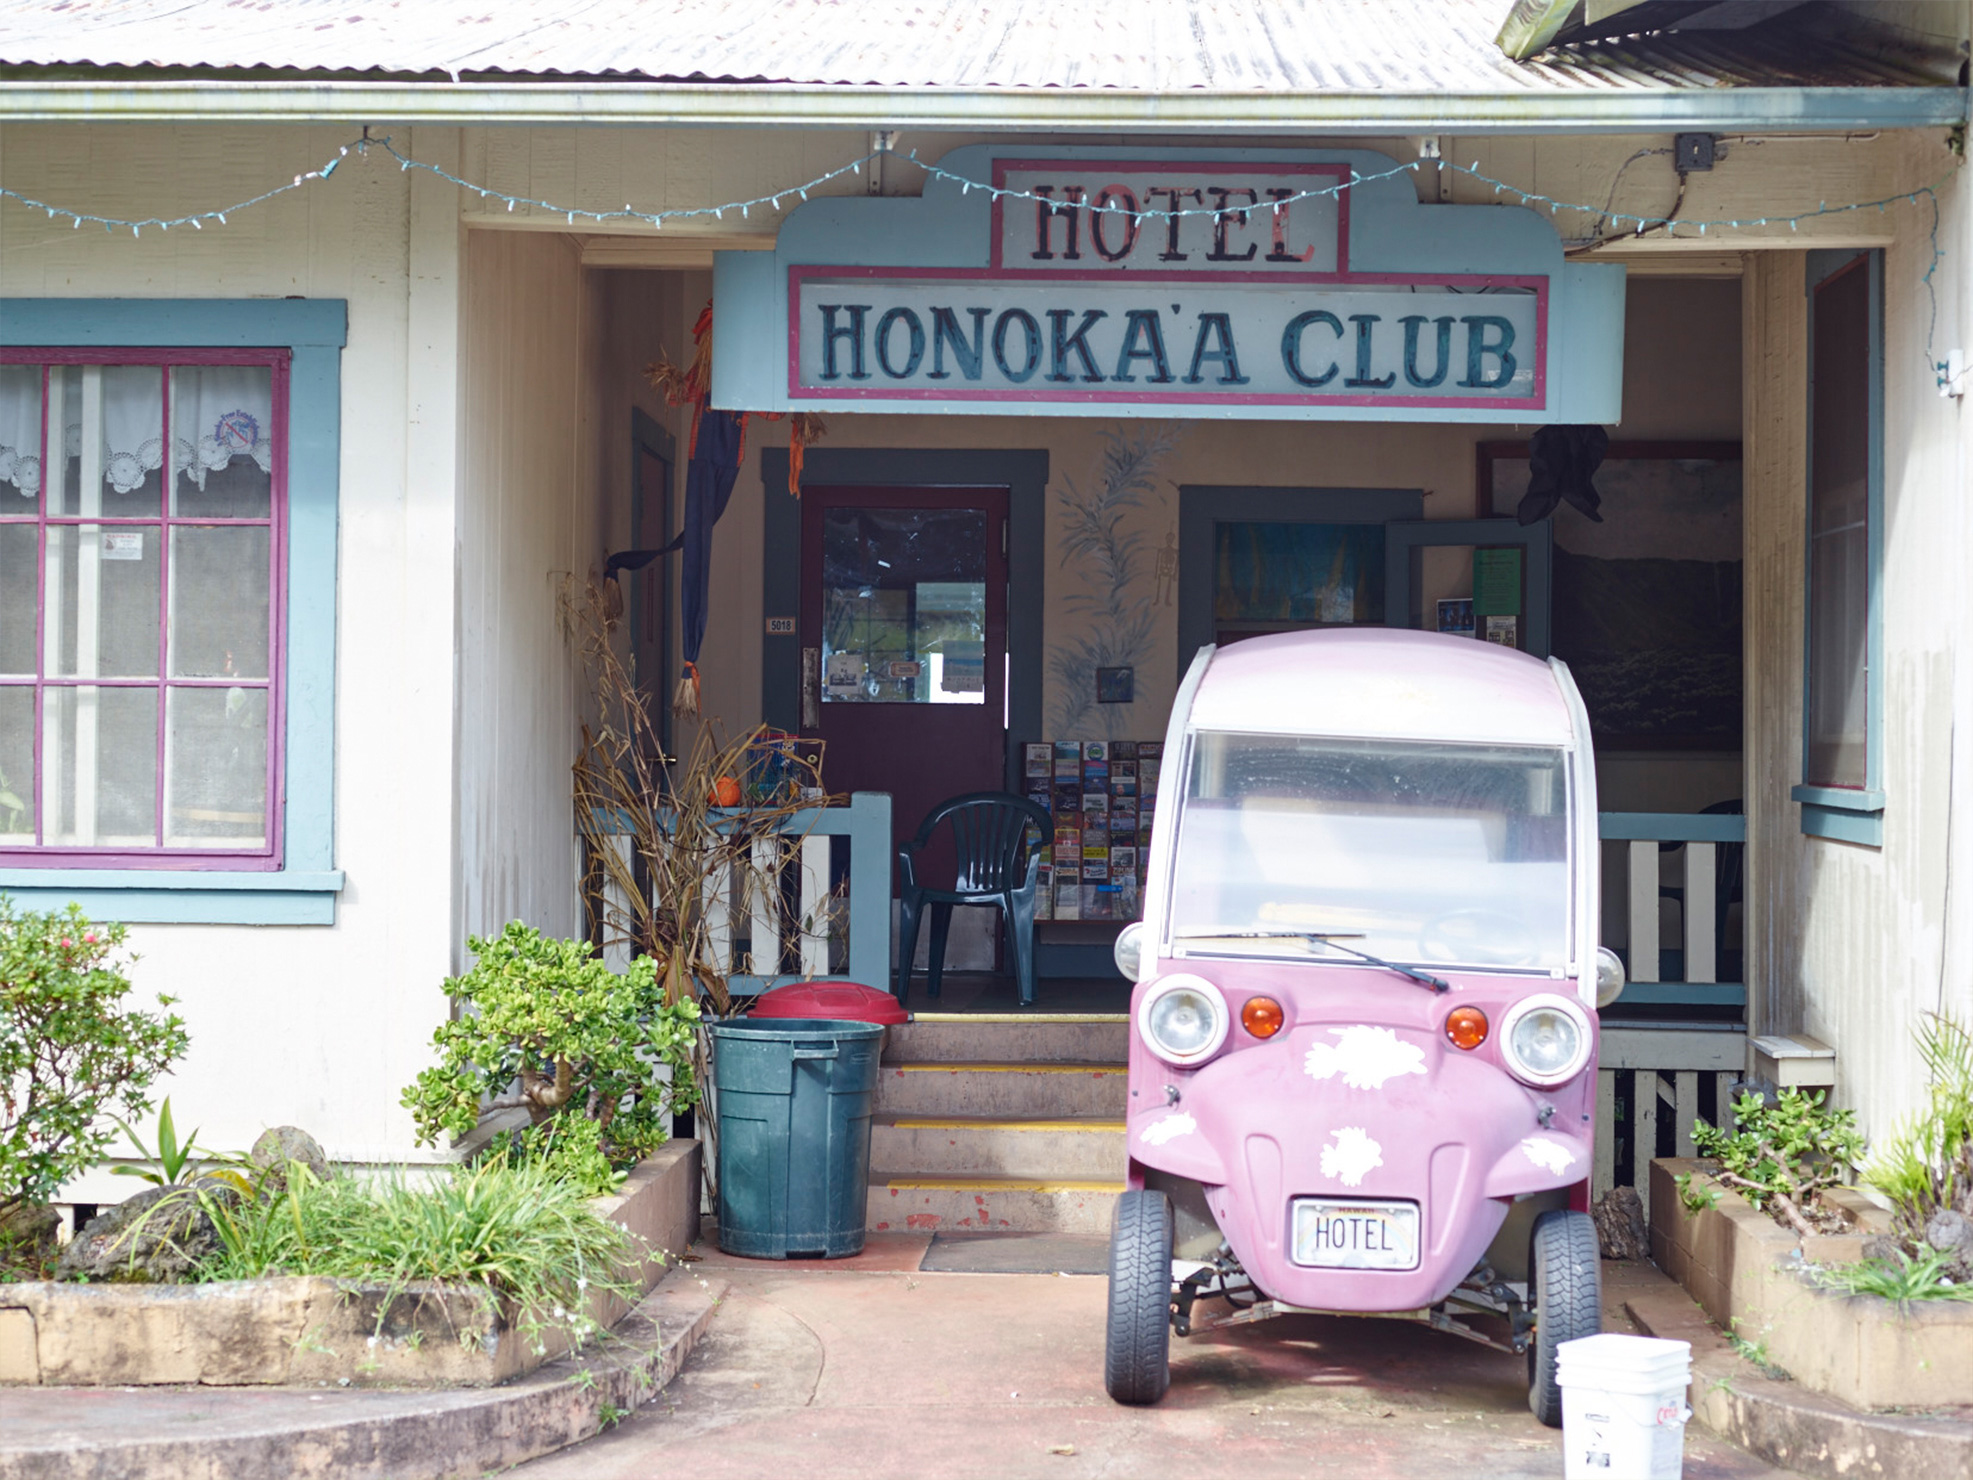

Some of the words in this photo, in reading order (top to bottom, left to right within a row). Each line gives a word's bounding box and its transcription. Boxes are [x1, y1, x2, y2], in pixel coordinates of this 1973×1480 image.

[1030, 183, 1315, 262] HOTEL
[818, 304, 1250, 385] HONOKA'A
[1281, 310, 1517, 389] CLUB
[771, 620, 792, 631] 5018
[1316, 1217, 1394, 1252] HOTEL
